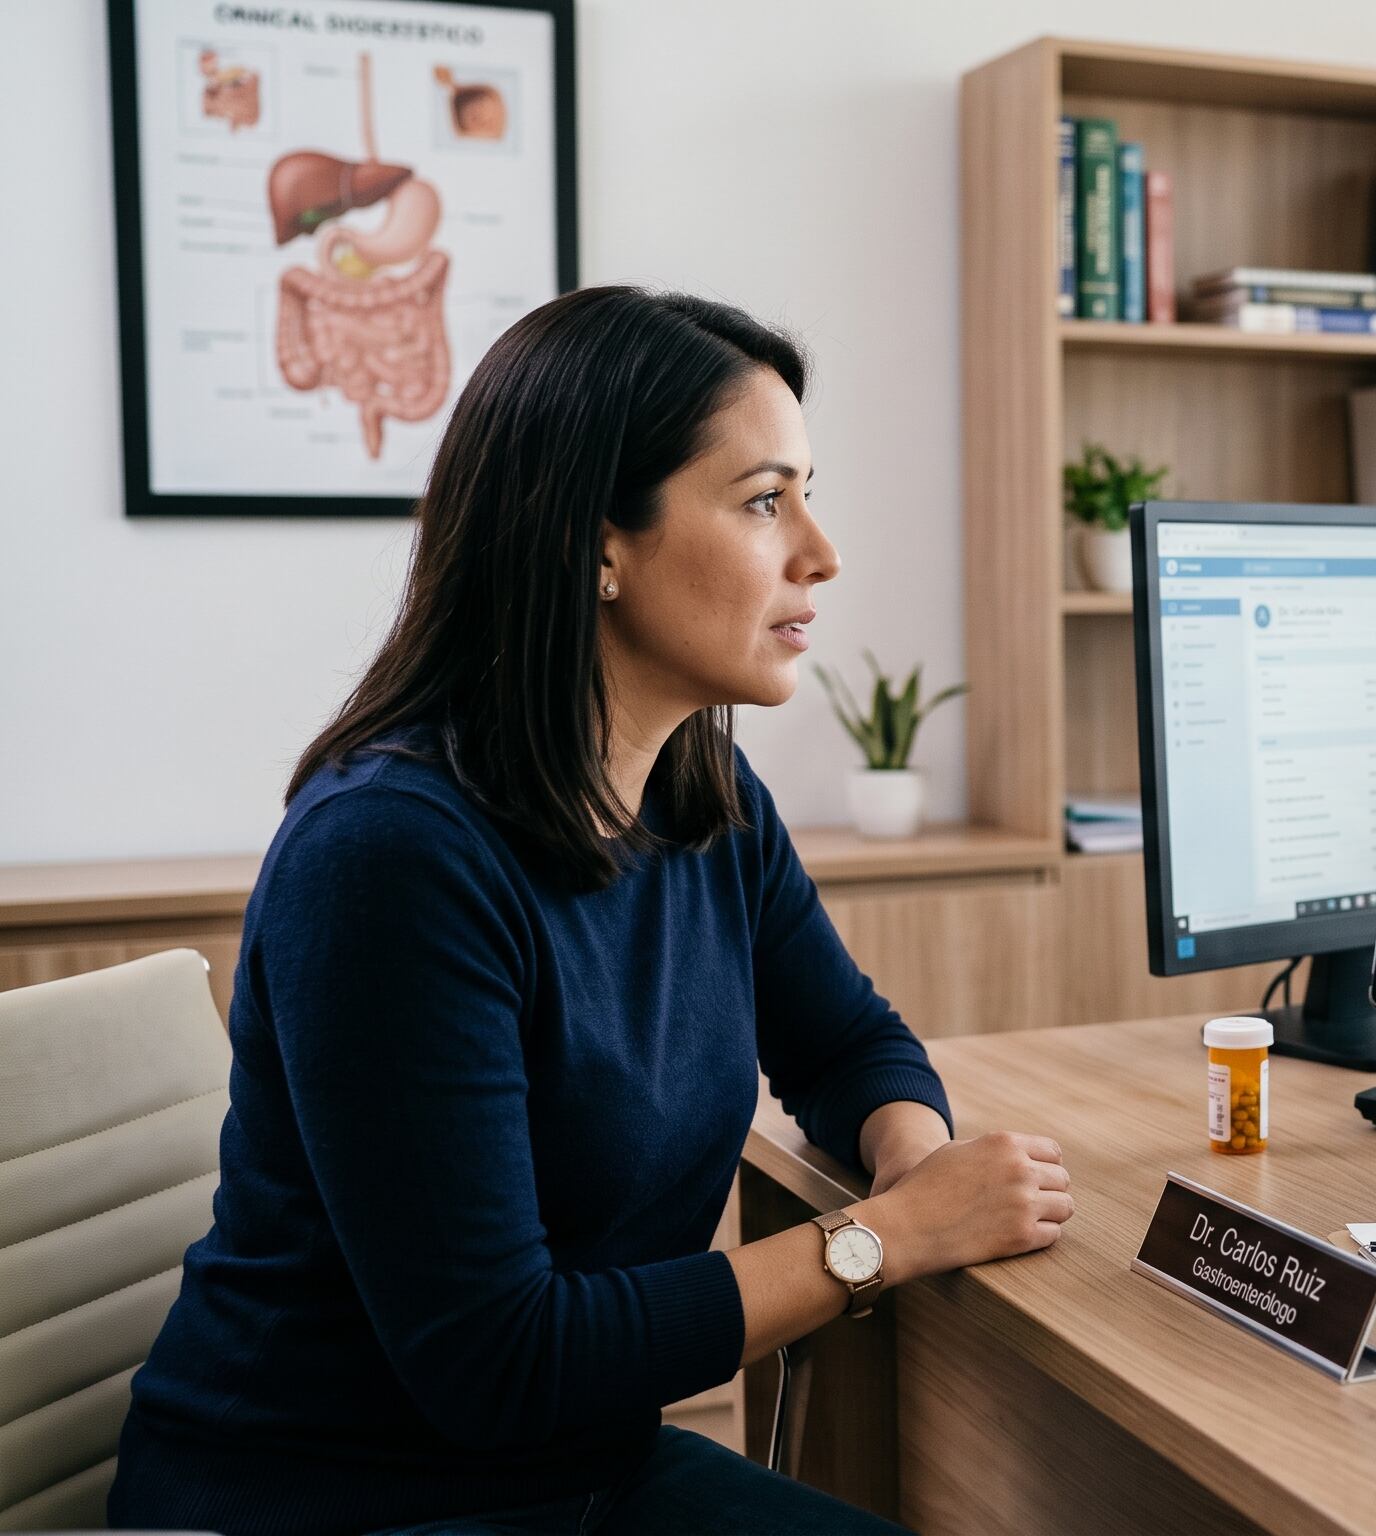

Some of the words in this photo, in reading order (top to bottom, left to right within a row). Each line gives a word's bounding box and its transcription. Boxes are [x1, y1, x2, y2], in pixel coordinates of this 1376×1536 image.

[1190, 1213, 1216, 1248] Dr.
[1219, 1227, 1278, 1278] Carlos
[1279, 1256, 1326, 1302] Ruiz
[1192, 1256, 1297, 1325] Gastroenterólogo
